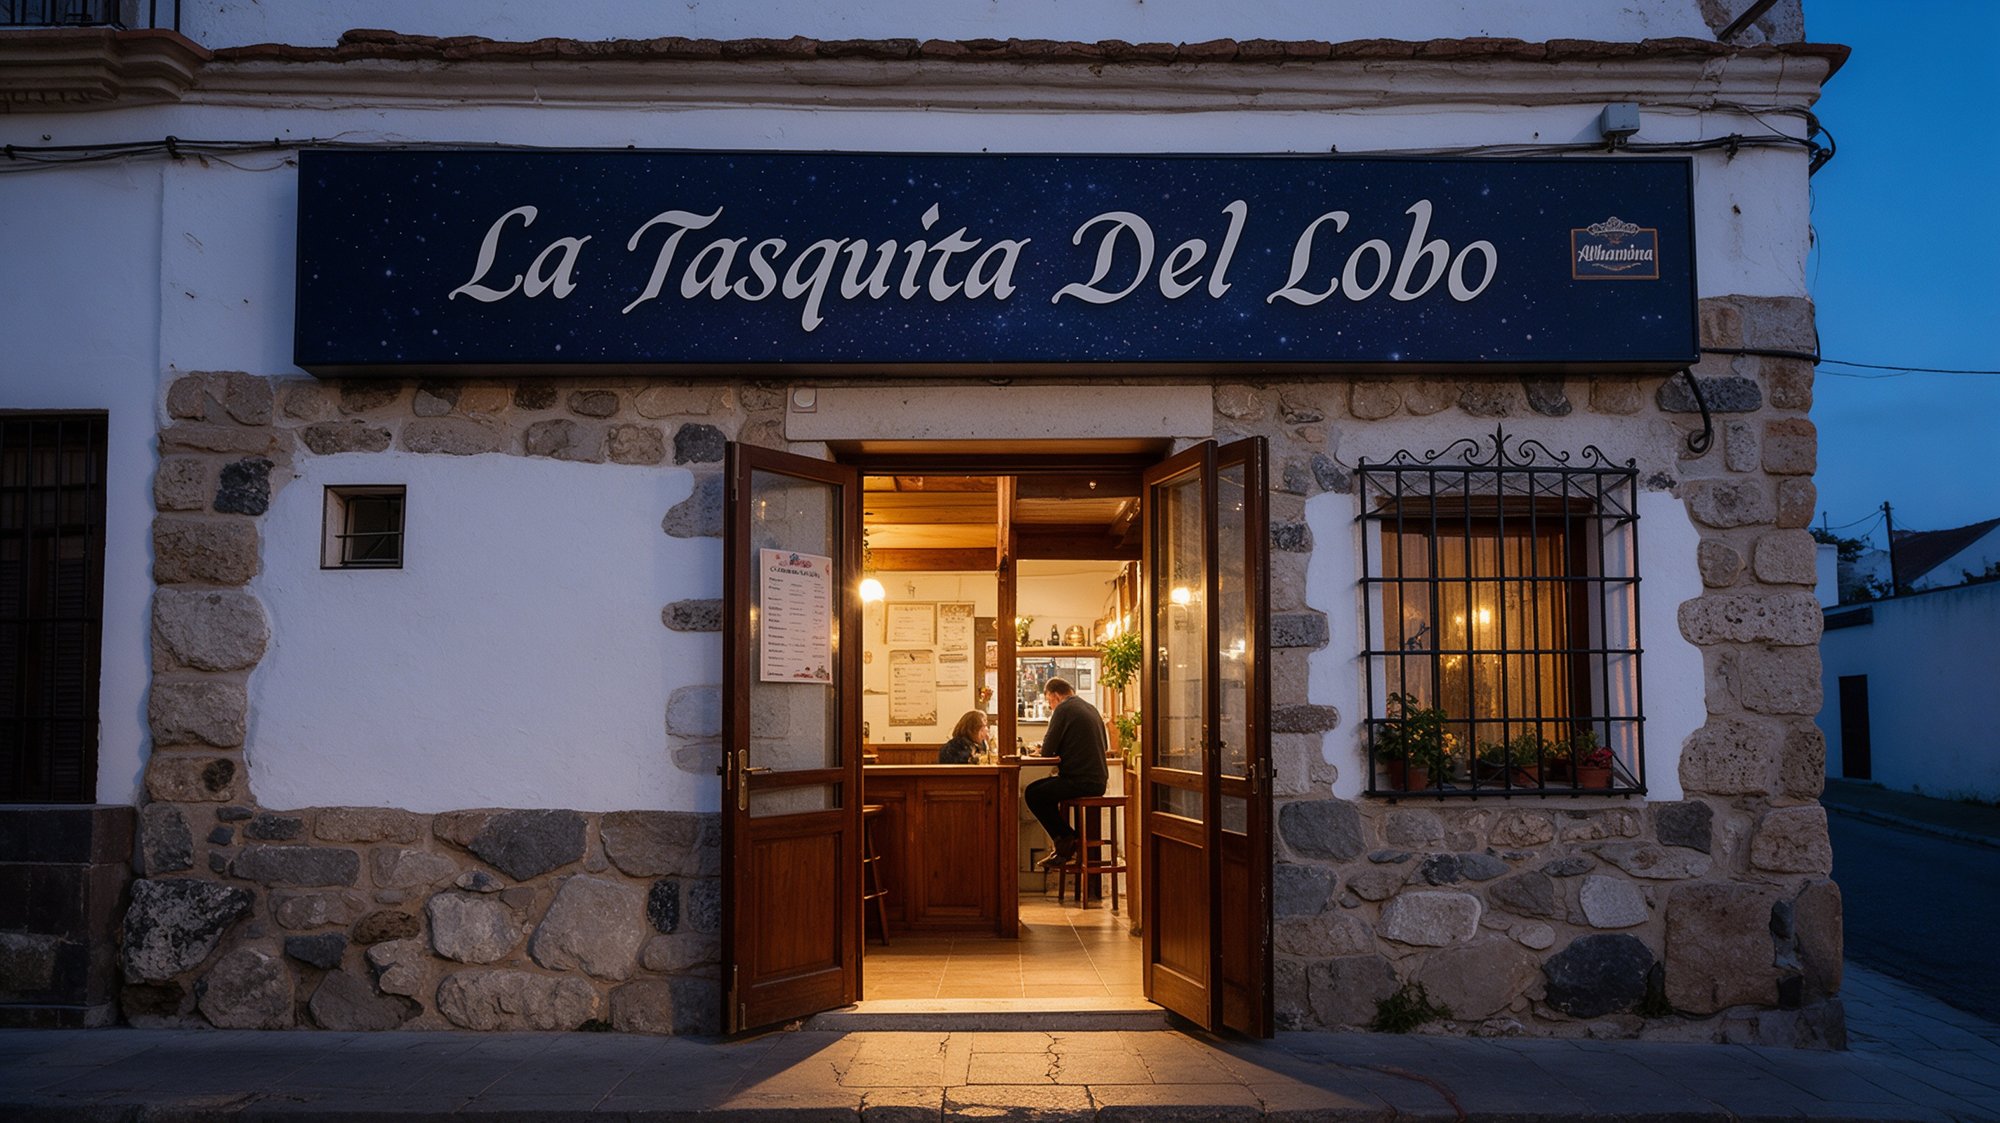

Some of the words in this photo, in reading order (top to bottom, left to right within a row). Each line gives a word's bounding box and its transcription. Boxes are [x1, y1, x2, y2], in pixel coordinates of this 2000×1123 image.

[448, 205, 592, 302] La
[621, 202, 1032, 332] Tasquita
[1051, 199, 1248, 304] Del
[1266, 199, 1498, 306] Lobo
